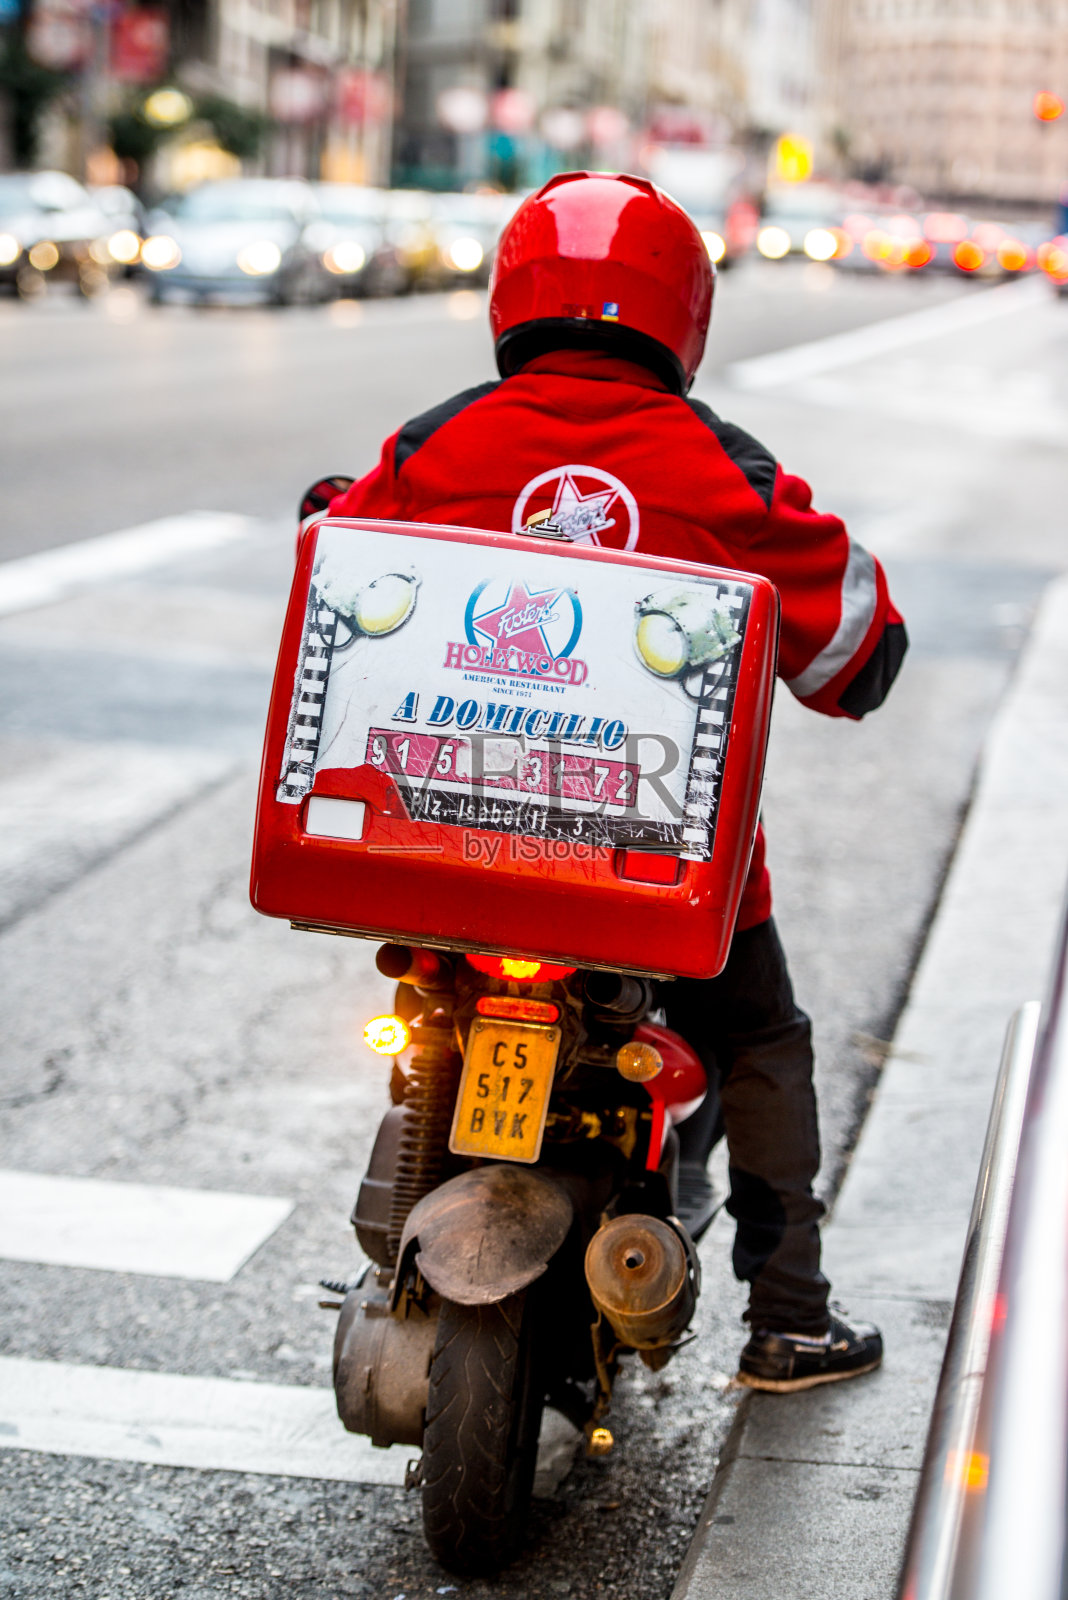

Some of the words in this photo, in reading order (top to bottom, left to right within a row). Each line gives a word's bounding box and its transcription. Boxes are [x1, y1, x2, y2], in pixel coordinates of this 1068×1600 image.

[497, 598, 558, 639] Foster's
[443, 642, 588, 685] HOLLYWOOD
[463, 673, 506, 686] AMERICAN
[509, 679, 566, 694] RESTAURANT
[492, 687, 514, 695] SINCE
[391, 691, 419, 723] A
[425, 695, 628, 751] DOMICILIO
[476, 1073, 534, 1104] 517
